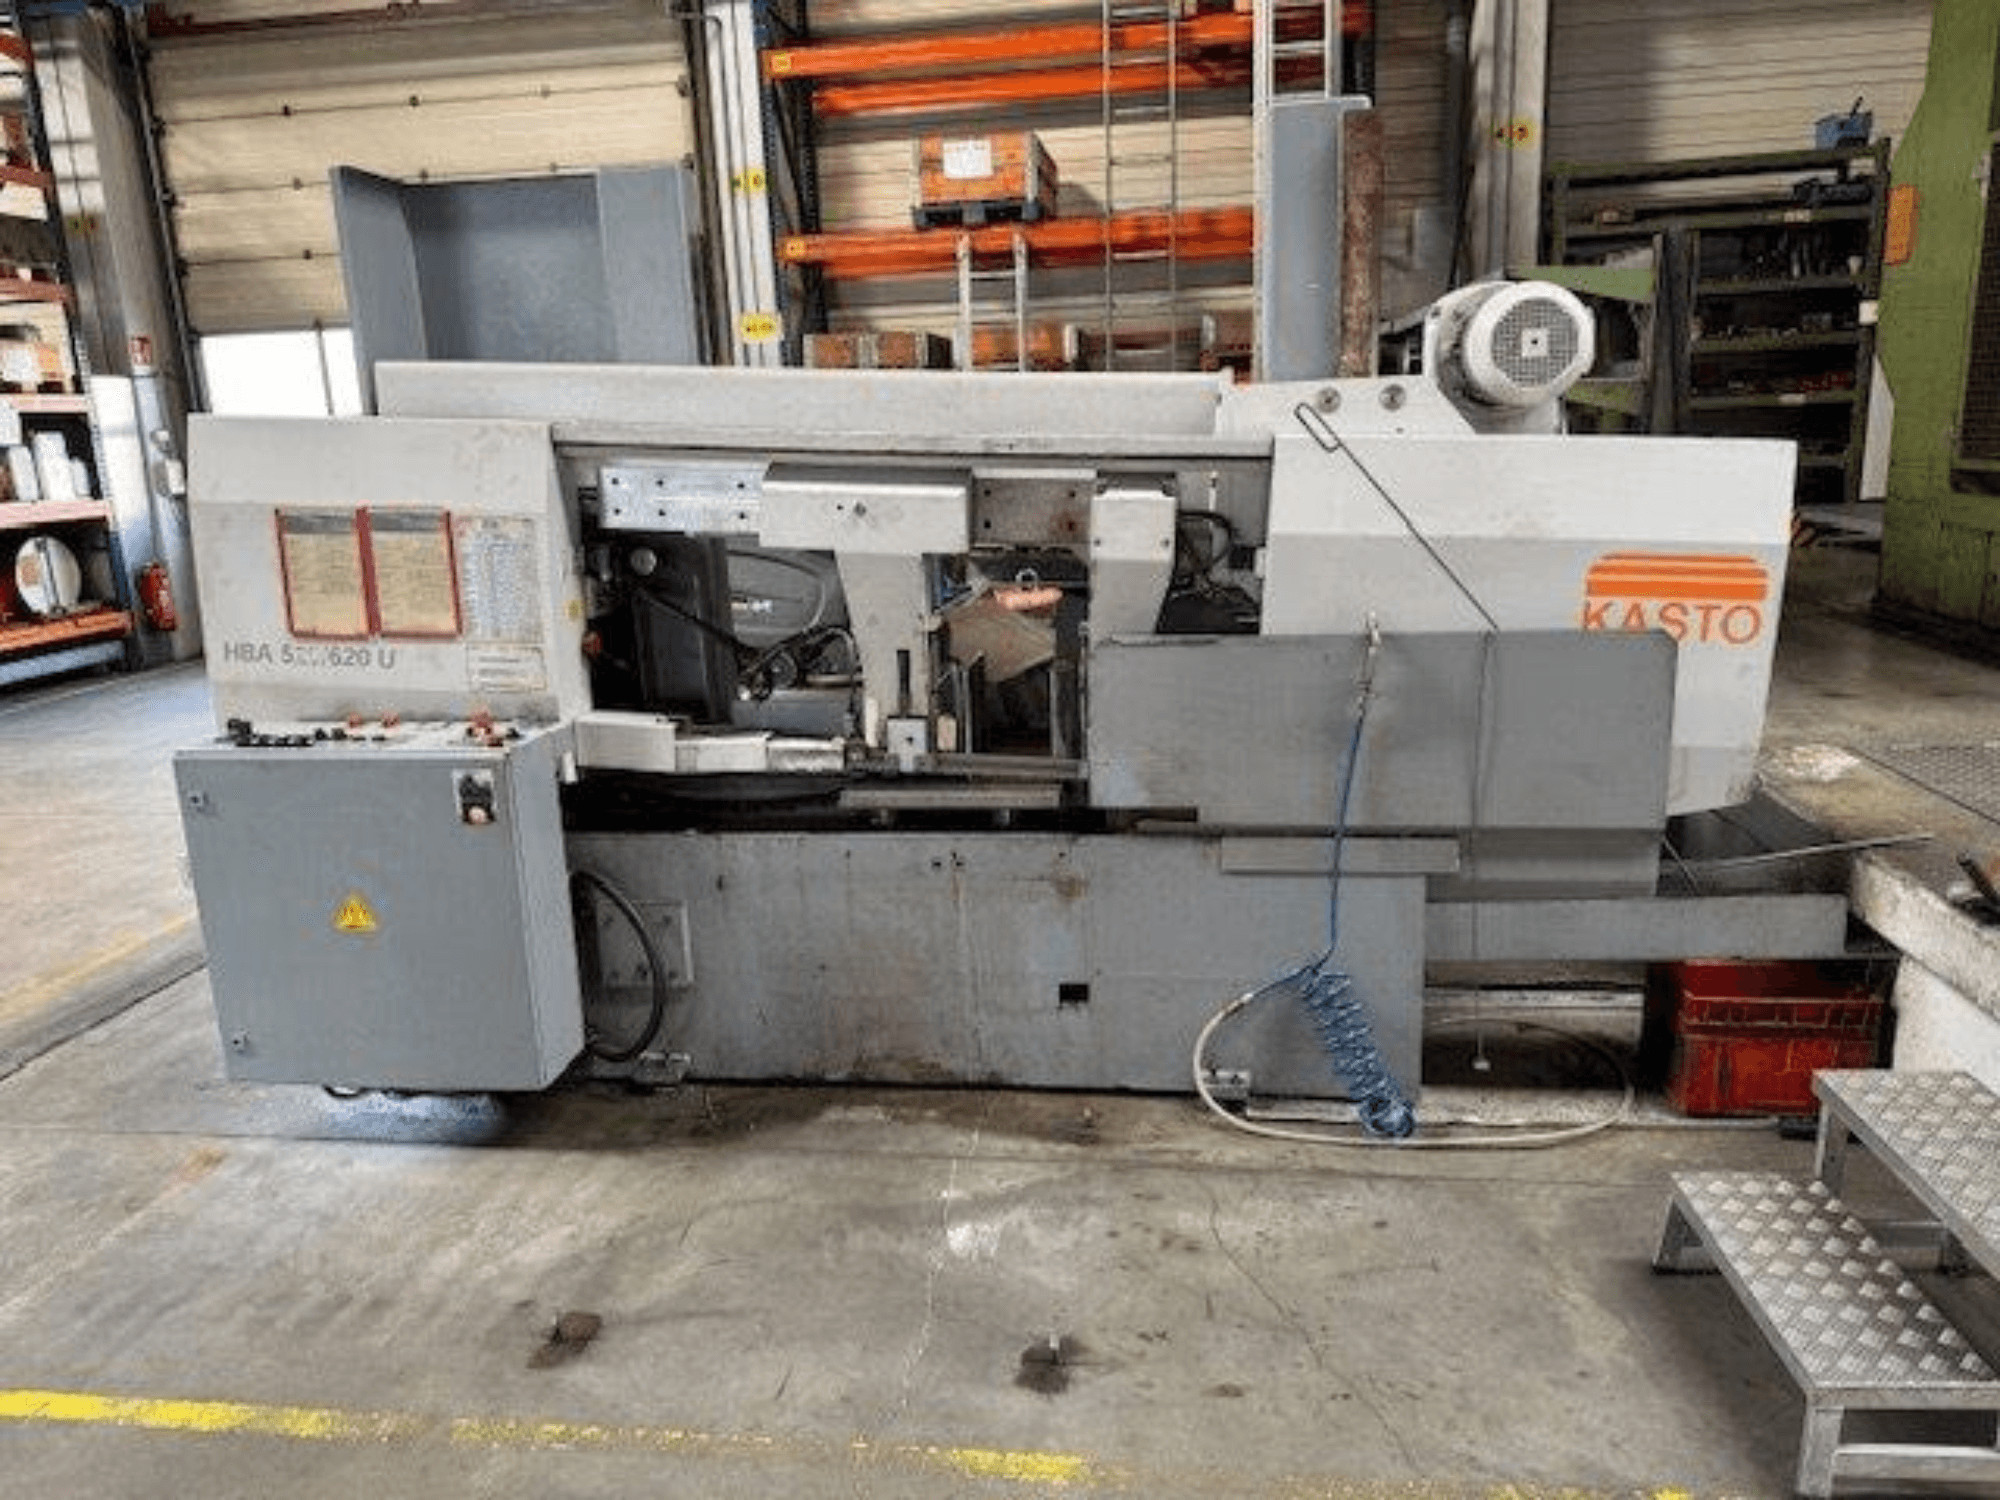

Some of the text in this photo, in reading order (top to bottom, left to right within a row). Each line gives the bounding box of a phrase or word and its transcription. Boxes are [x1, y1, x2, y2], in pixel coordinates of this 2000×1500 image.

[1582, 600, 1762, 645] KASTO
[223, 641, 273, 664] HBA
[377, 648, 396, 670] U
